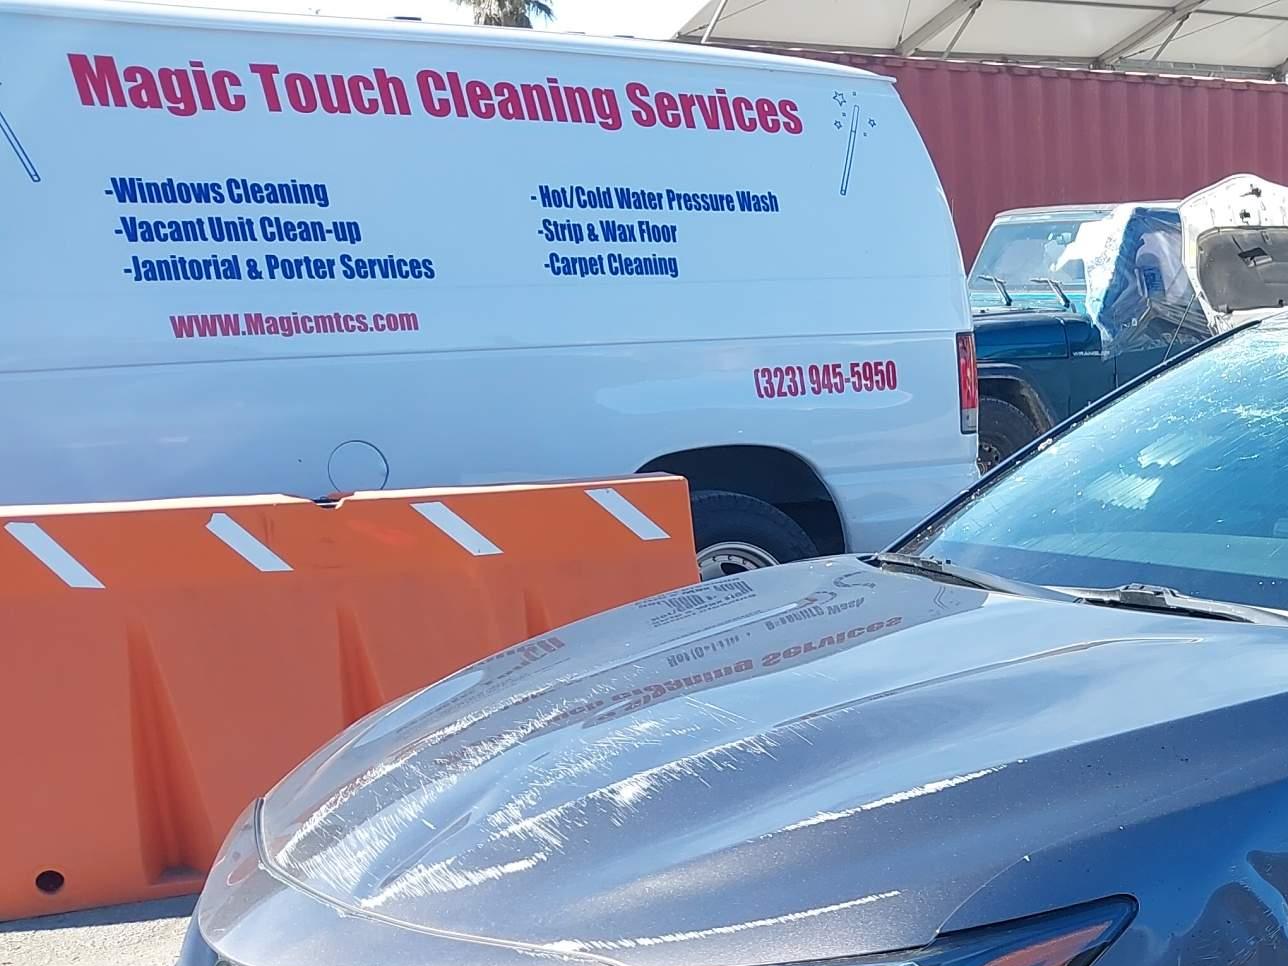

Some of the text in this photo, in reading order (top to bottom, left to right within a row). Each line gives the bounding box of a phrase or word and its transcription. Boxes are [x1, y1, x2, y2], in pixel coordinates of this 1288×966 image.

[67, 53, 803, 135] Magic Touch Cleaning Services
[105, 177, 329, 208] -Windows Cleaning
[539, 185, 613, 209] Hot/Cold
[614, 187, 663, 210] Water
[666, 189, 735, 211] Pressure
[736, 190, 779, 212] Wash
[115, 216, 361, 244] -Vacant Unit Clean-up
[538, 219, 677, 244] -Strip & Wax Floor
[124, 253, 435, 282] -Janitorial & Porter Services
[544, 252, 679, 278] -Carpet Cleaning
[754, 360, 897, 398] (323) 945-5950
